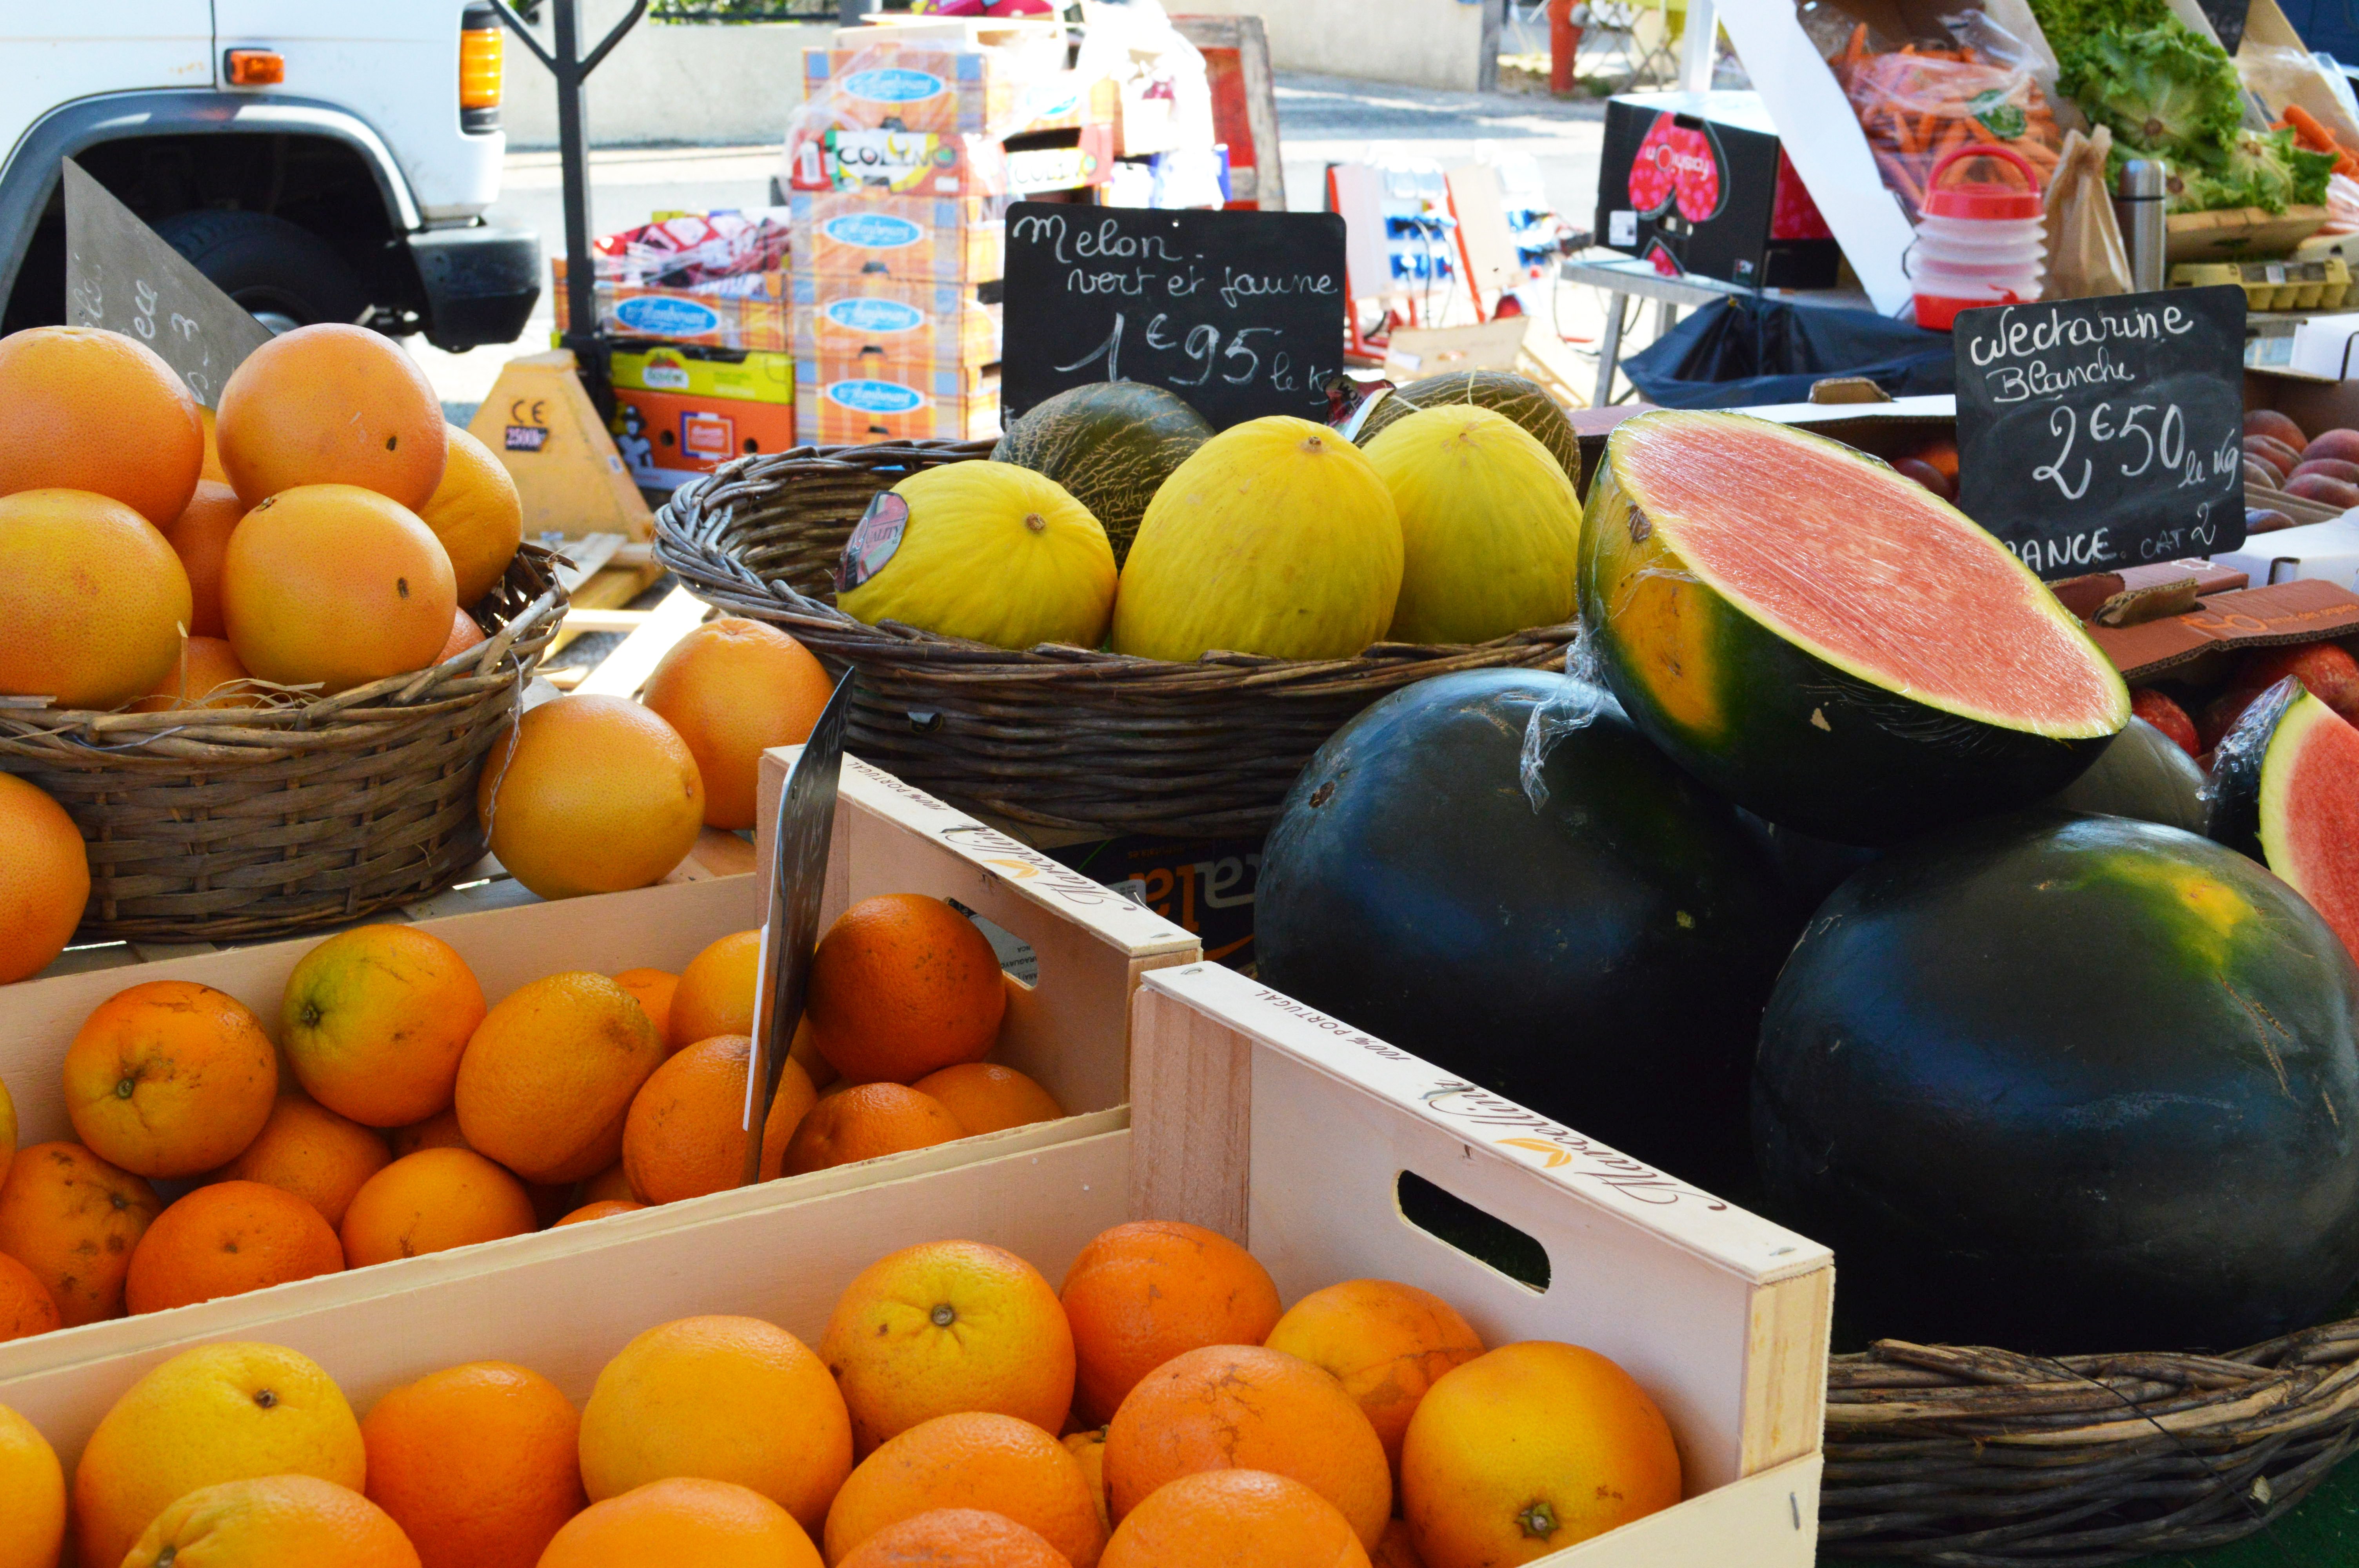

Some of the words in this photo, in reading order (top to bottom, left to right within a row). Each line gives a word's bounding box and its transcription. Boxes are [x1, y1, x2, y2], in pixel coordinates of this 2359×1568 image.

[1068, 266, 1156, 295] vert
[1168, 266, 1205, 296] et
[1221, 266, 1338, 308] jaune
[1270, 352, 1299, 391] le
[1986, 347, 2135, 402] Blanche
[2178, 450, 2206, 488] le
[2003, 527, 2116, 571] ANCE
[2141, 528, 2185, 559] CAT
[2191, 502, 2216, 545] 2
[846, 761, 905, 793] PORTUGAL
[903, 794, 949, 811] 100%
[1255, 989, 1347, 1036] PORTUGAL
[1346, 1036, 1412, 1061] 100%
